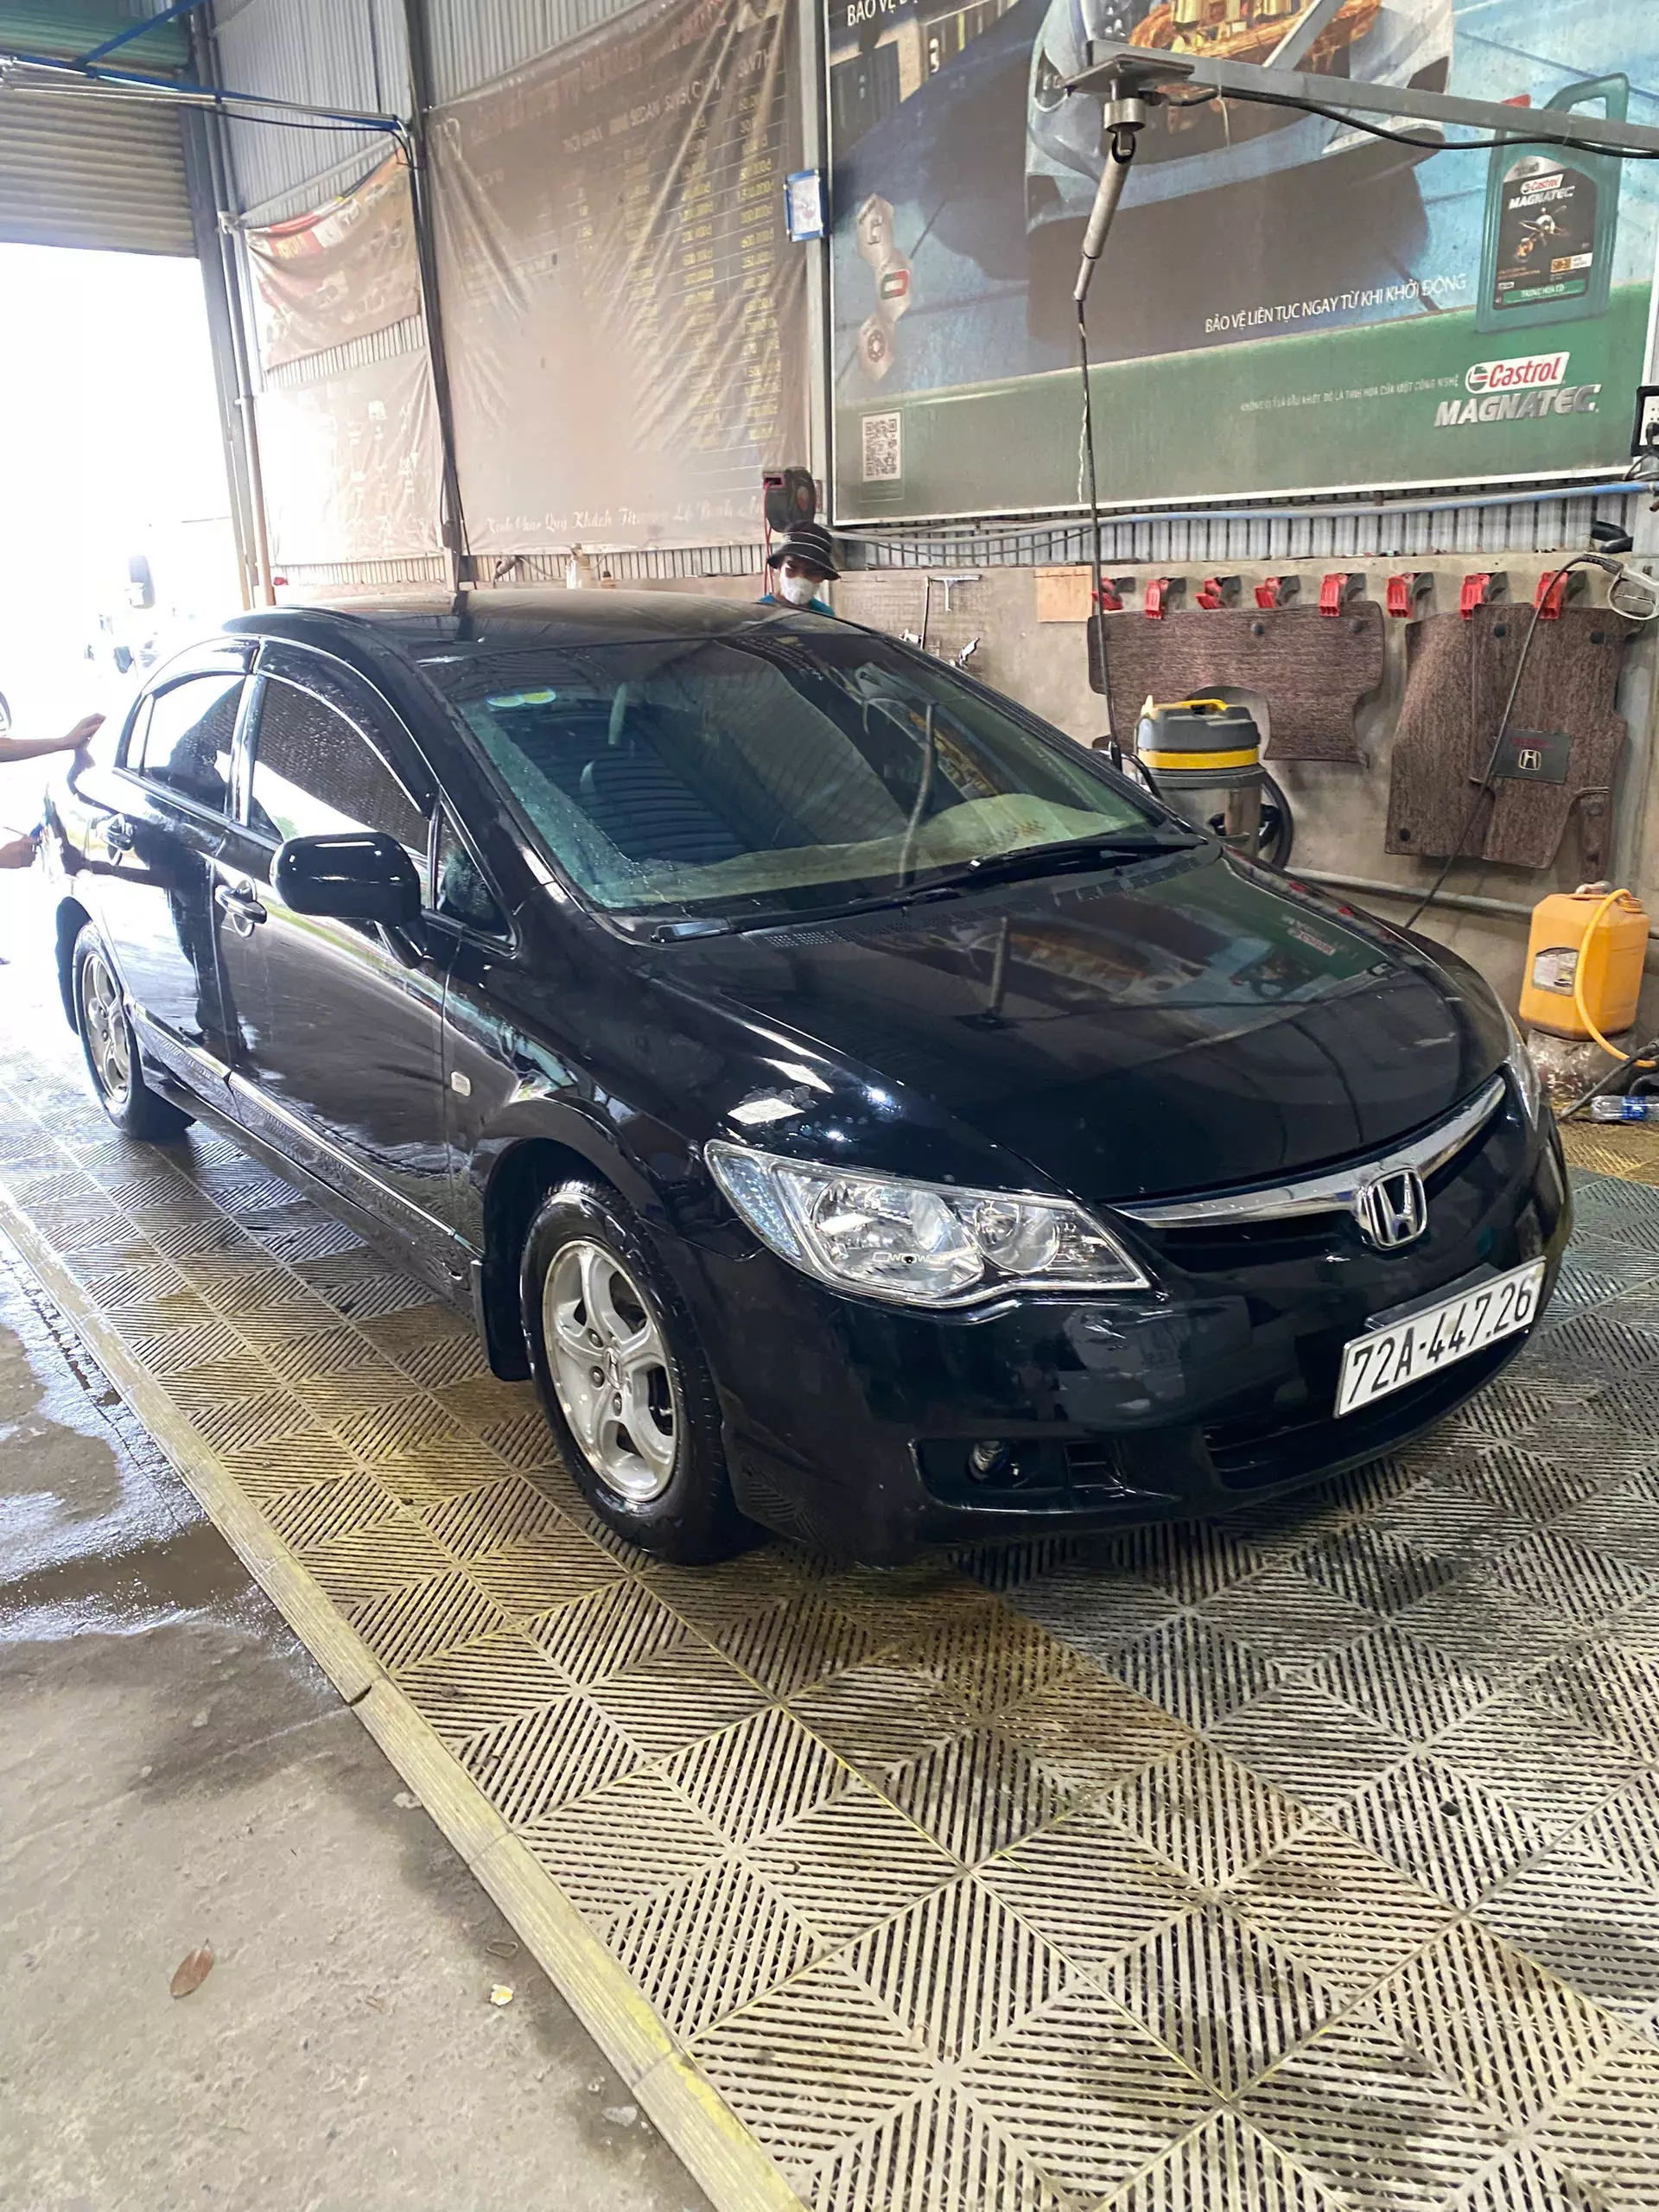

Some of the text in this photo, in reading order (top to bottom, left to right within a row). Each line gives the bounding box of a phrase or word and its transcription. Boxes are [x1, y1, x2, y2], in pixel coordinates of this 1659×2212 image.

[1509, 186, 1575, 209] MAGNATEC
[1205, 314, 1230, 334] BẢO
[1274, 302, 1300, 323] TỤC
[1302, 296, 1338, 317] NGAY
[1341, 290, 1359, 309] TỪ
[1361, 289, 1383, 307] KHI
[1386, 278, 1420, 302] KHỞI
[1489, 356, 1562, 388] Castrol
[1433, 384, 1602, 428] MAGNATEC
